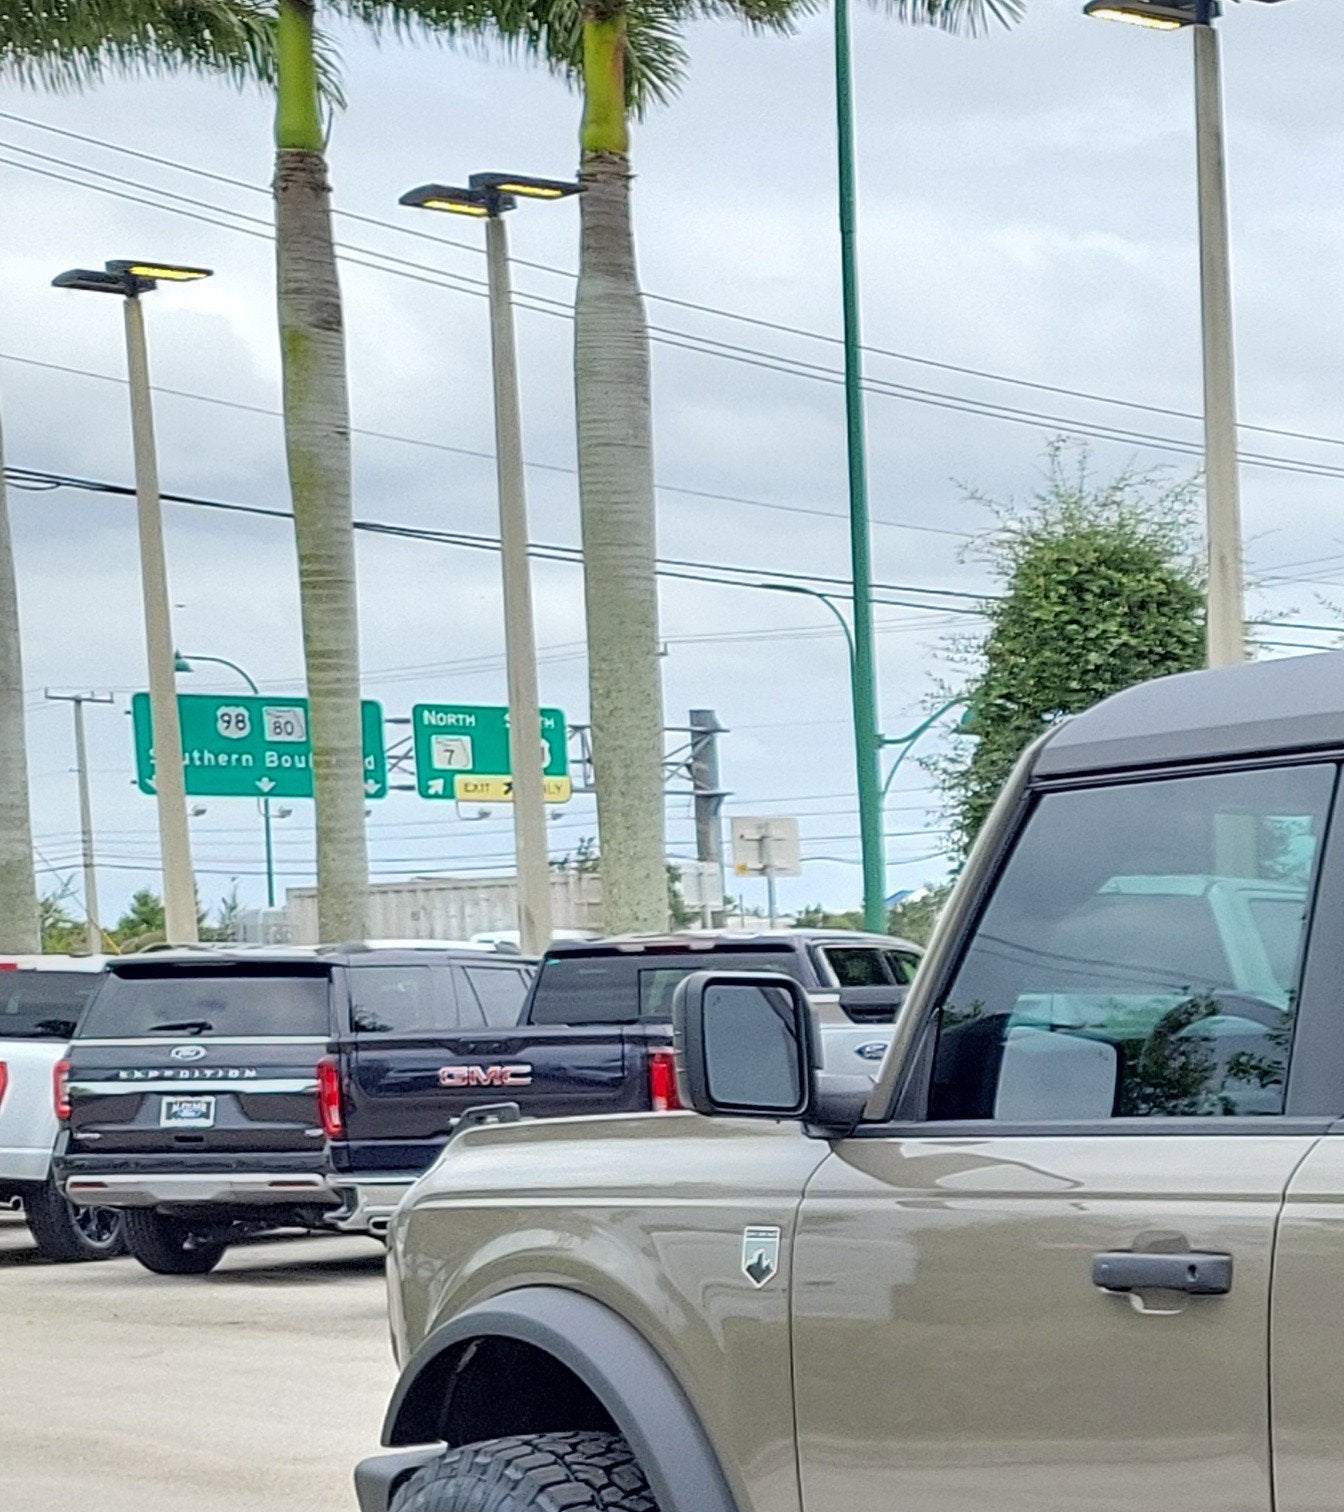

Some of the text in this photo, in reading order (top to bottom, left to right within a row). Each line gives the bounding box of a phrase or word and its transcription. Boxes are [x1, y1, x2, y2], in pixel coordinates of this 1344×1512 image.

[220, 713, 247, 731] 98
[422, 709, 555, 729] NORTH STH
[273, 721, 295, 736] 80
[443, 750, 455, 765] 7
[464, 782, 491, 793] EXIT
[117, 1068, 257, 1079] EXPEDITION
[440, 1065, 532, 1086] GMC
